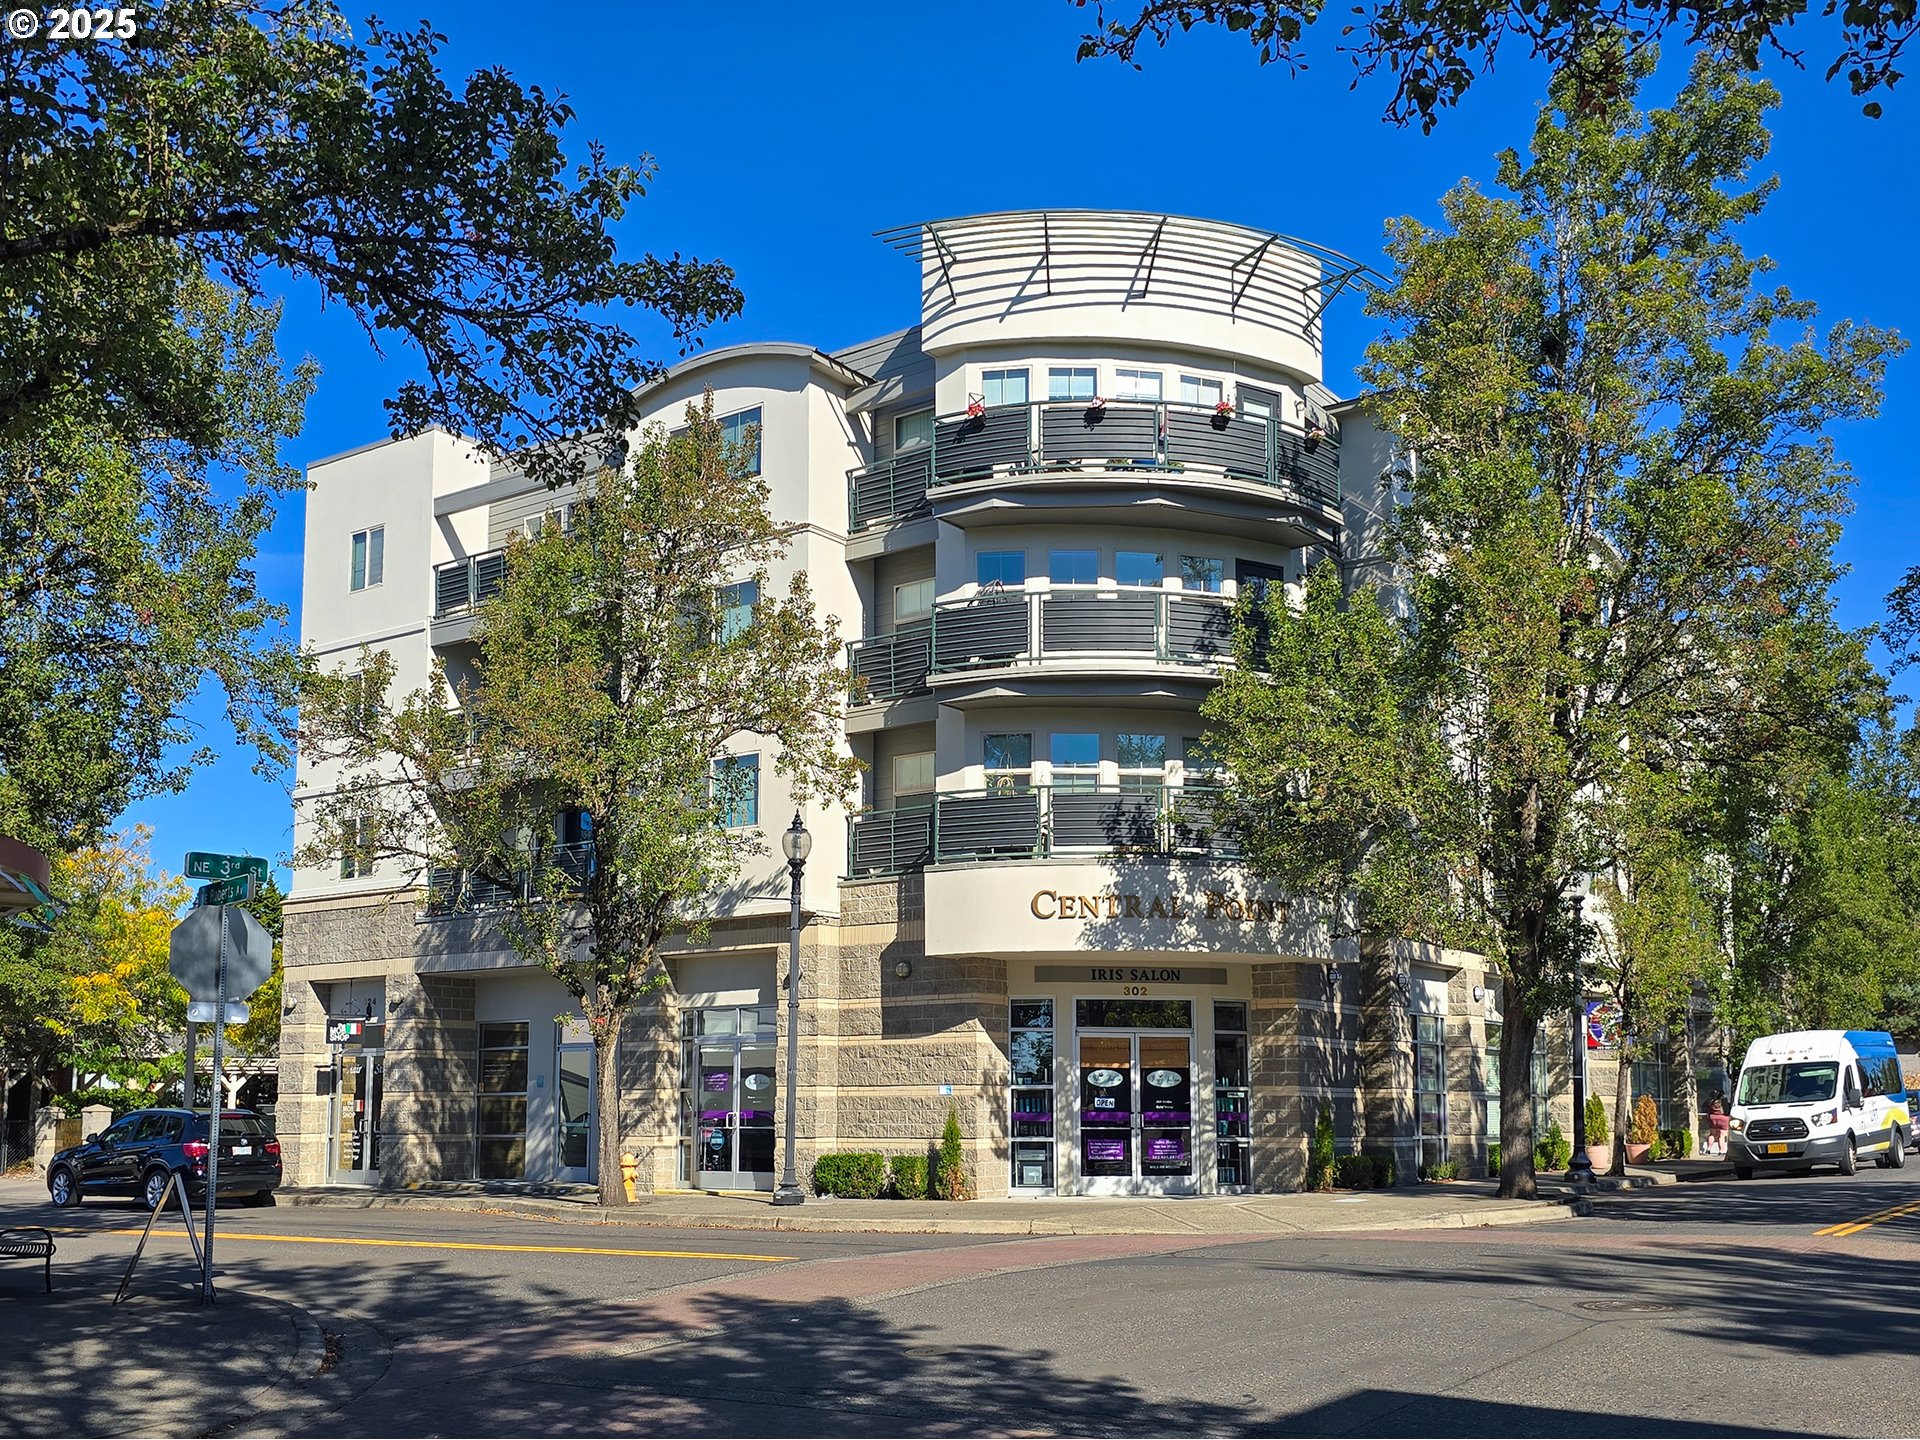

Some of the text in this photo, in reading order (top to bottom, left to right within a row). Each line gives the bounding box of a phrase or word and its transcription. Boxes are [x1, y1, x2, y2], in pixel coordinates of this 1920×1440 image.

[193, 860, 263, 878] NE 3rd St
[1030, 889, 1292, 923] CENTRAL POINT
[1091, 968, 1181, 982] IRIS SALON
[1123, 986, 1148, 996] 302
[1096, 1099, 1114, 1107] OPEN
